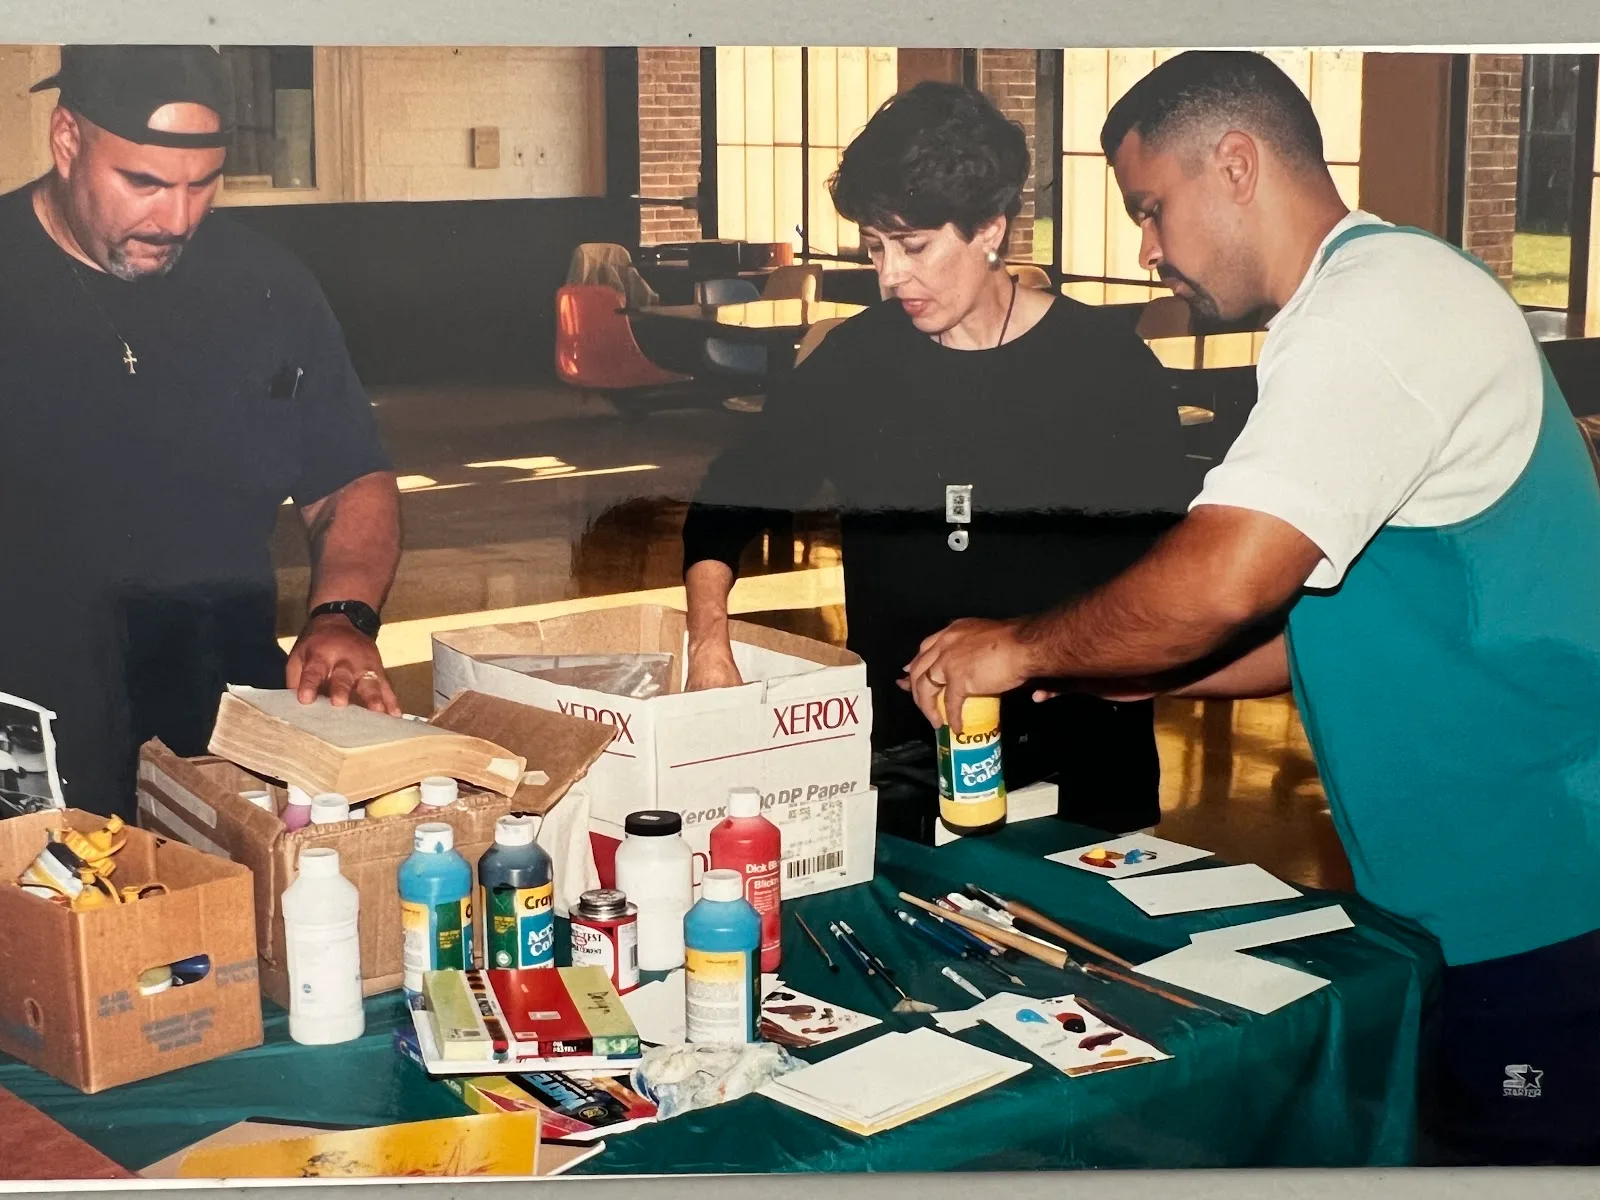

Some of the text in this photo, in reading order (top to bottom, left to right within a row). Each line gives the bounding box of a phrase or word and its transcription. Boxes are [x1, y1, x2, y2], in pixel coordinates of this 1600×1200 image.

[772, 695, 859, 738] XEROX
[777, 787, 803, 805] DP
[806, 781, 857, 801] Paper
[746, 863, 767, 874] Dick
[1503, 1088, 1542, 1098] STARTER
